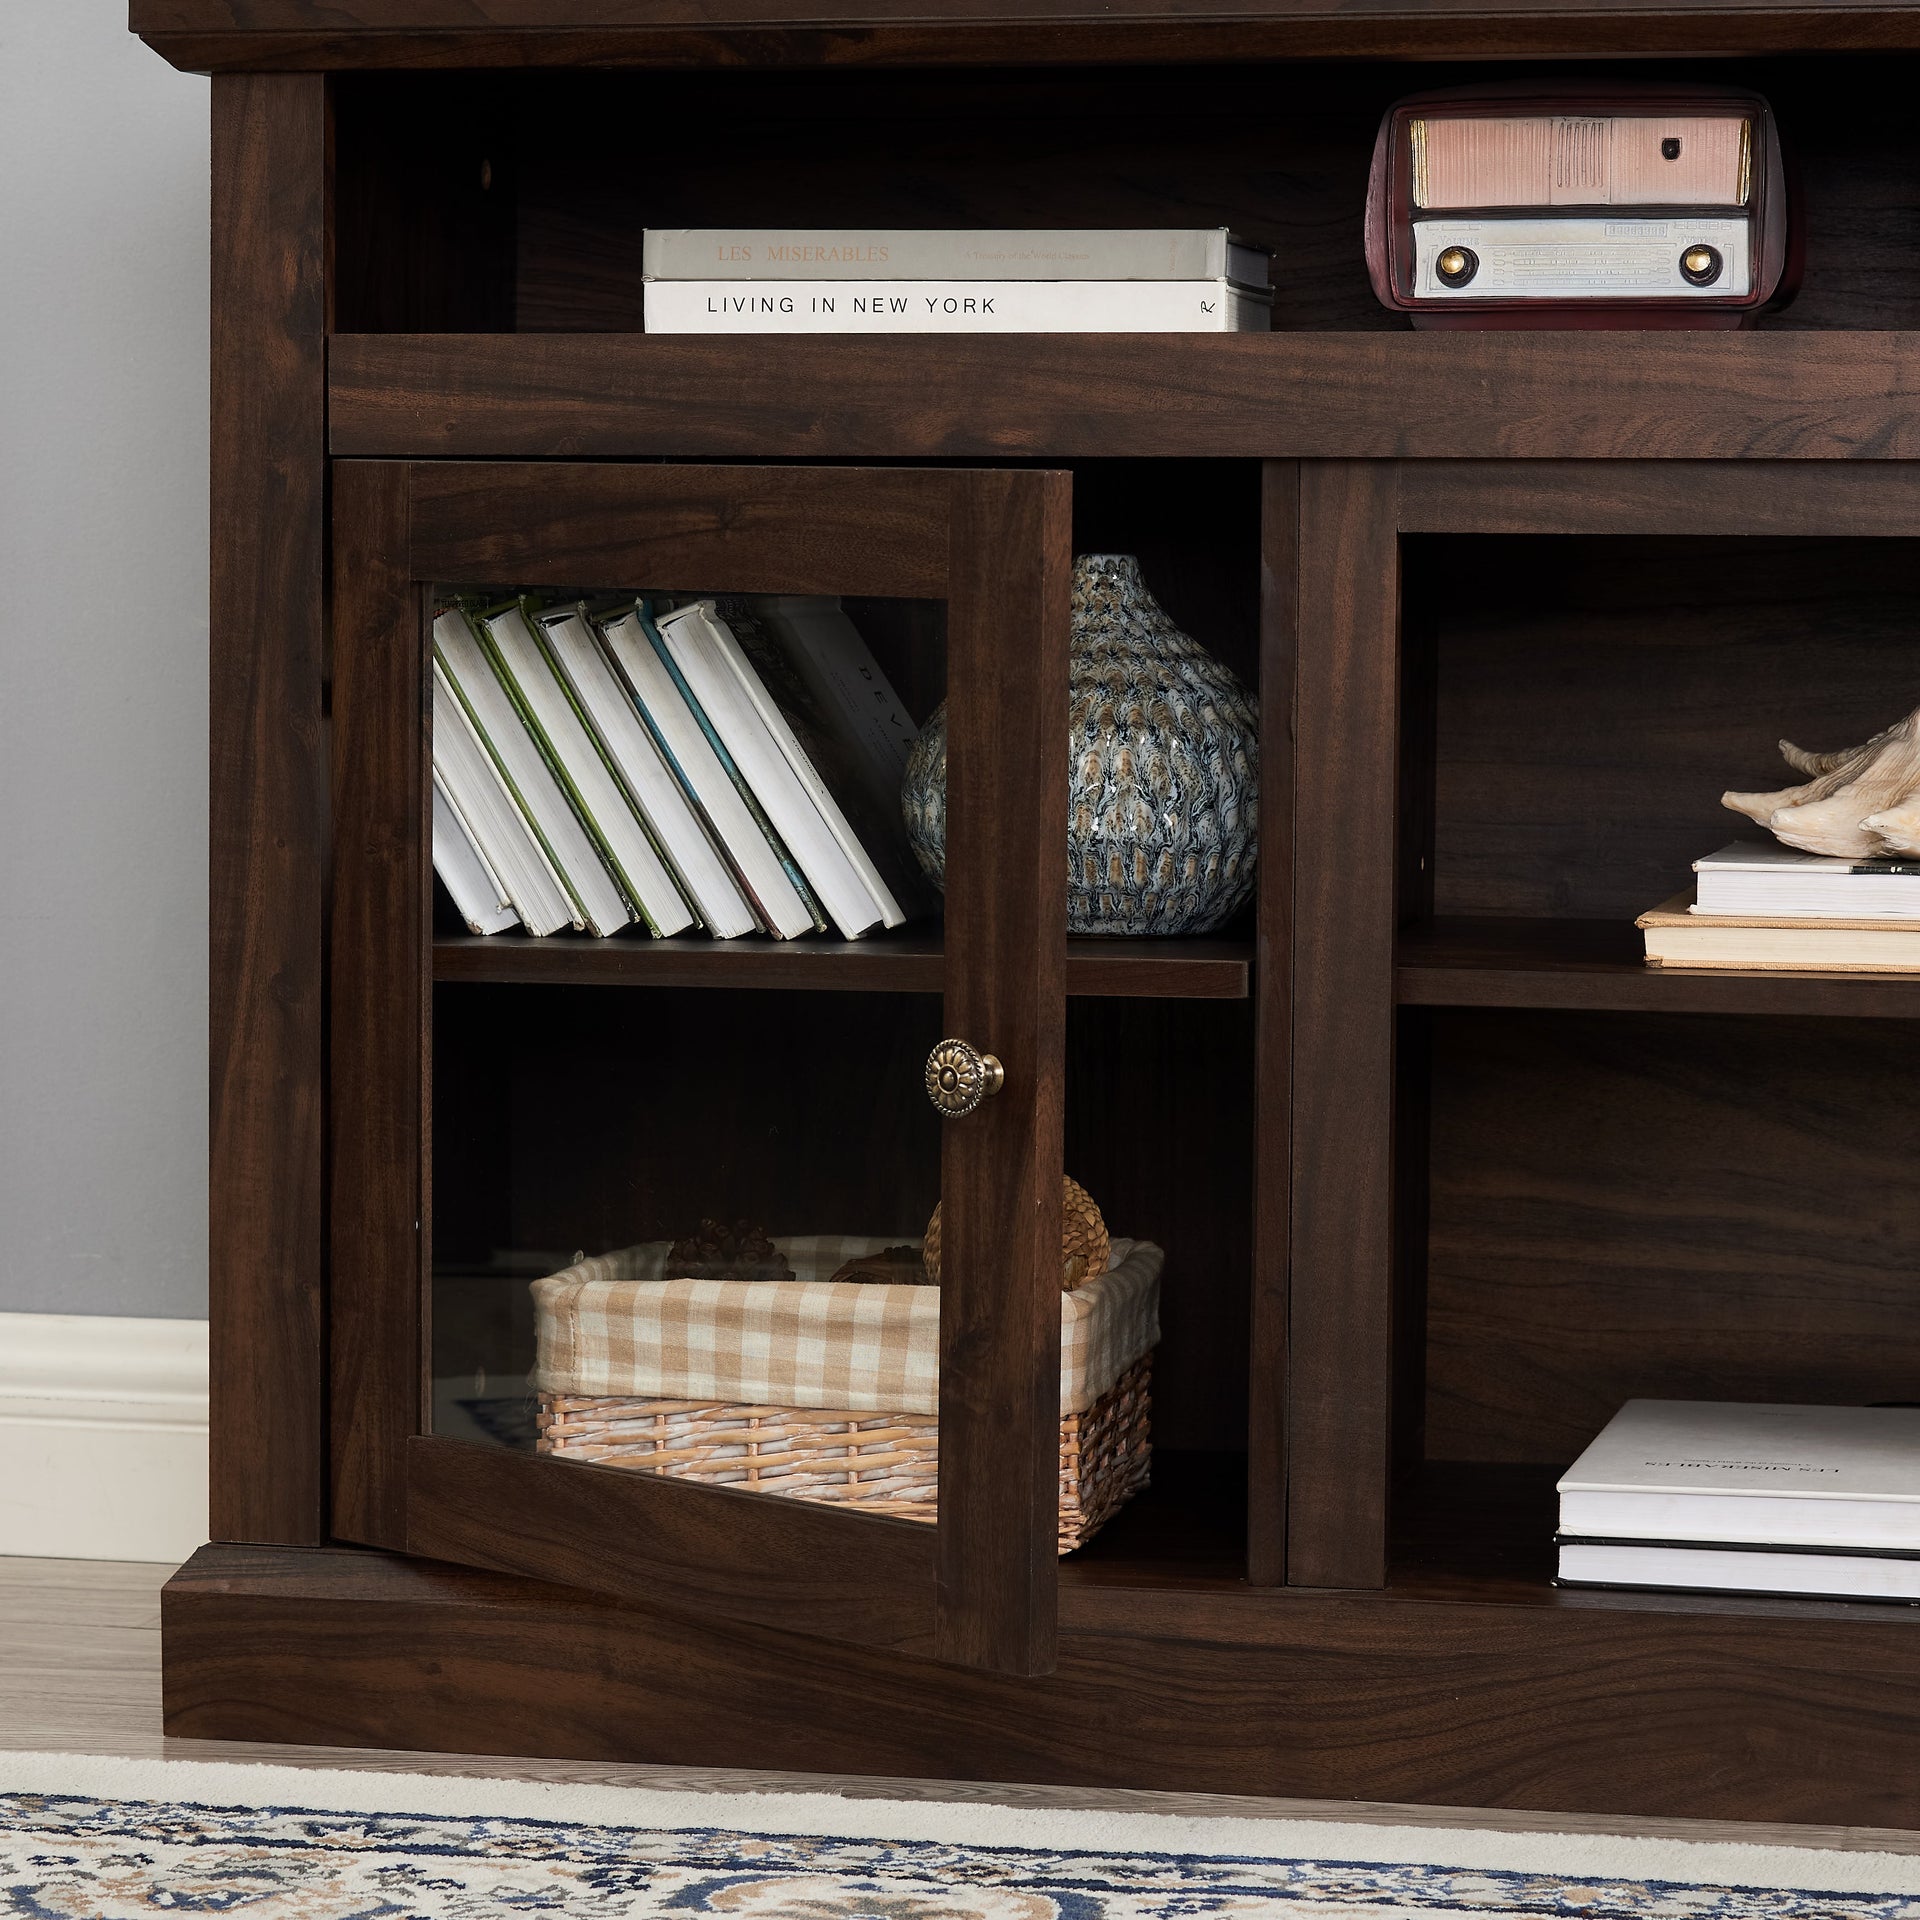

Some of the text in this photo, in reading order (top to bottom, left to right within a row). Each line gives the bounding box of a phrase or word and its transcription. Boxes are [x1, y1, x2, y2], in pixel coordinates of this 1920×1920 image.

[718, 246, 889, 261] LES MISERABLES
[707, 297, 995, 314] LIVING IN NEW YORK
